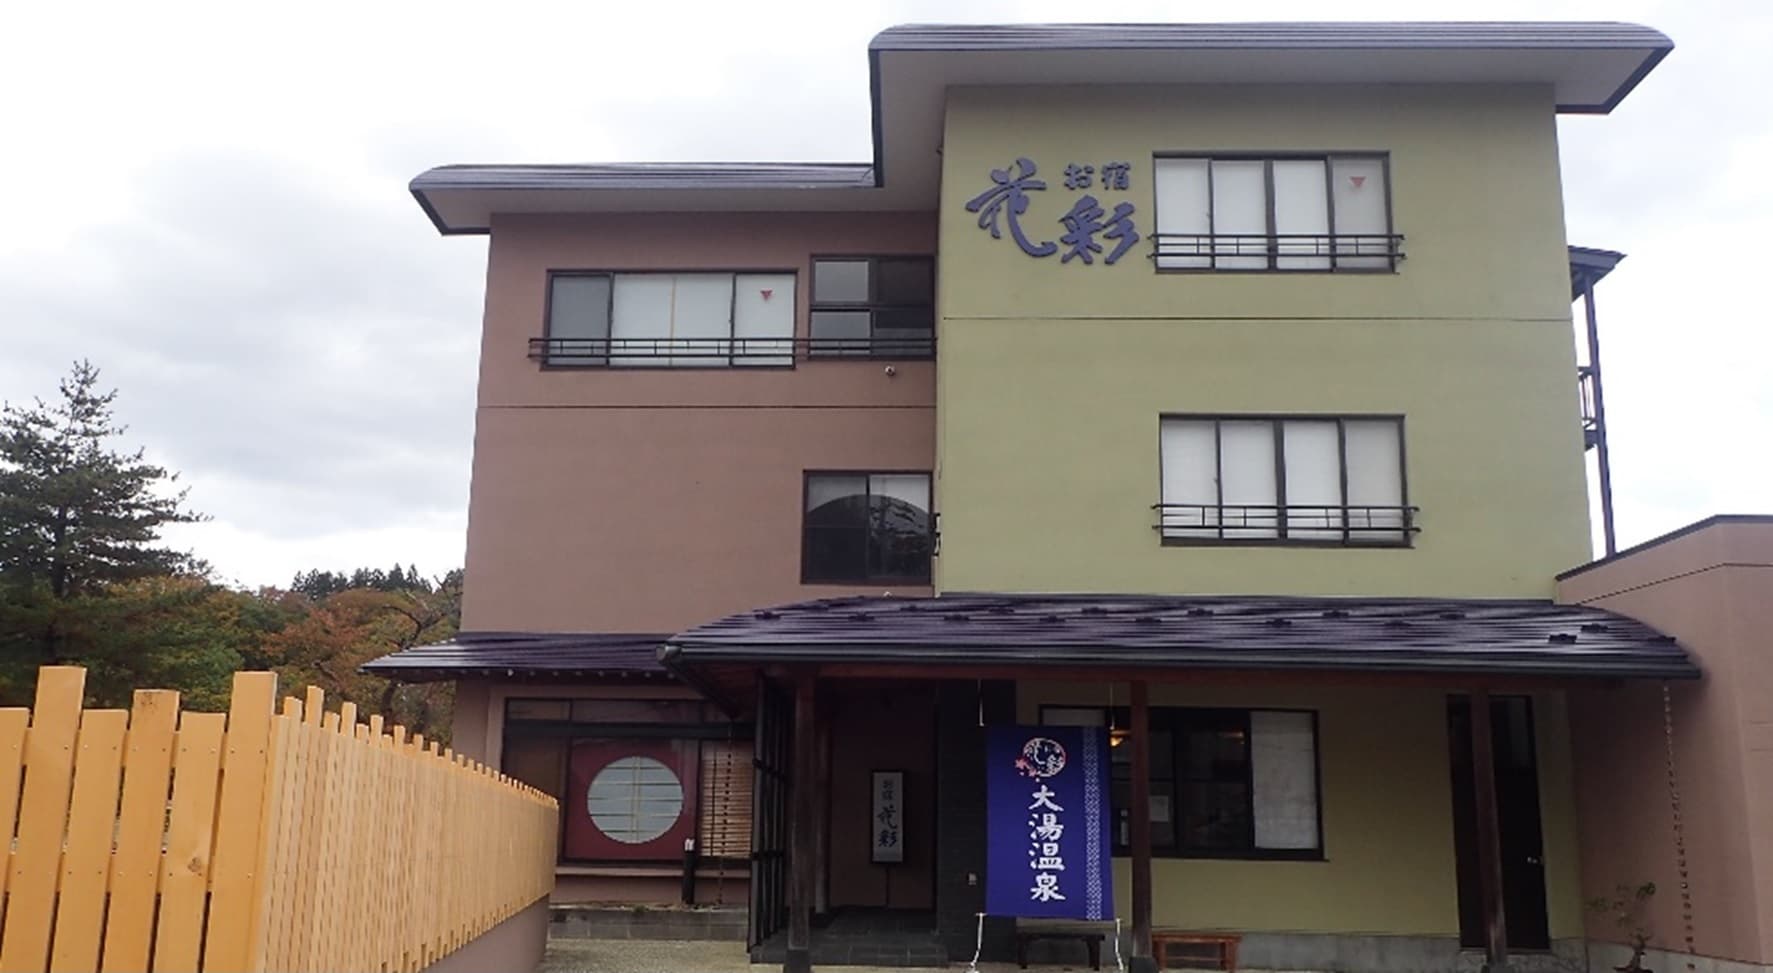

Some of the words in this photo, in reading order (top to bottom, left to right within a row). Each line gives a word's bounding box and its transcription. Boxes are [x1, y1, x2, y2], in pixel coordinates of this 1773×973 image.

[965, 157, 1140, 265] 花彩
[1063, 162, 1131, 190] お宿
[1028, 784, 1066, 902] 大湯温泉
